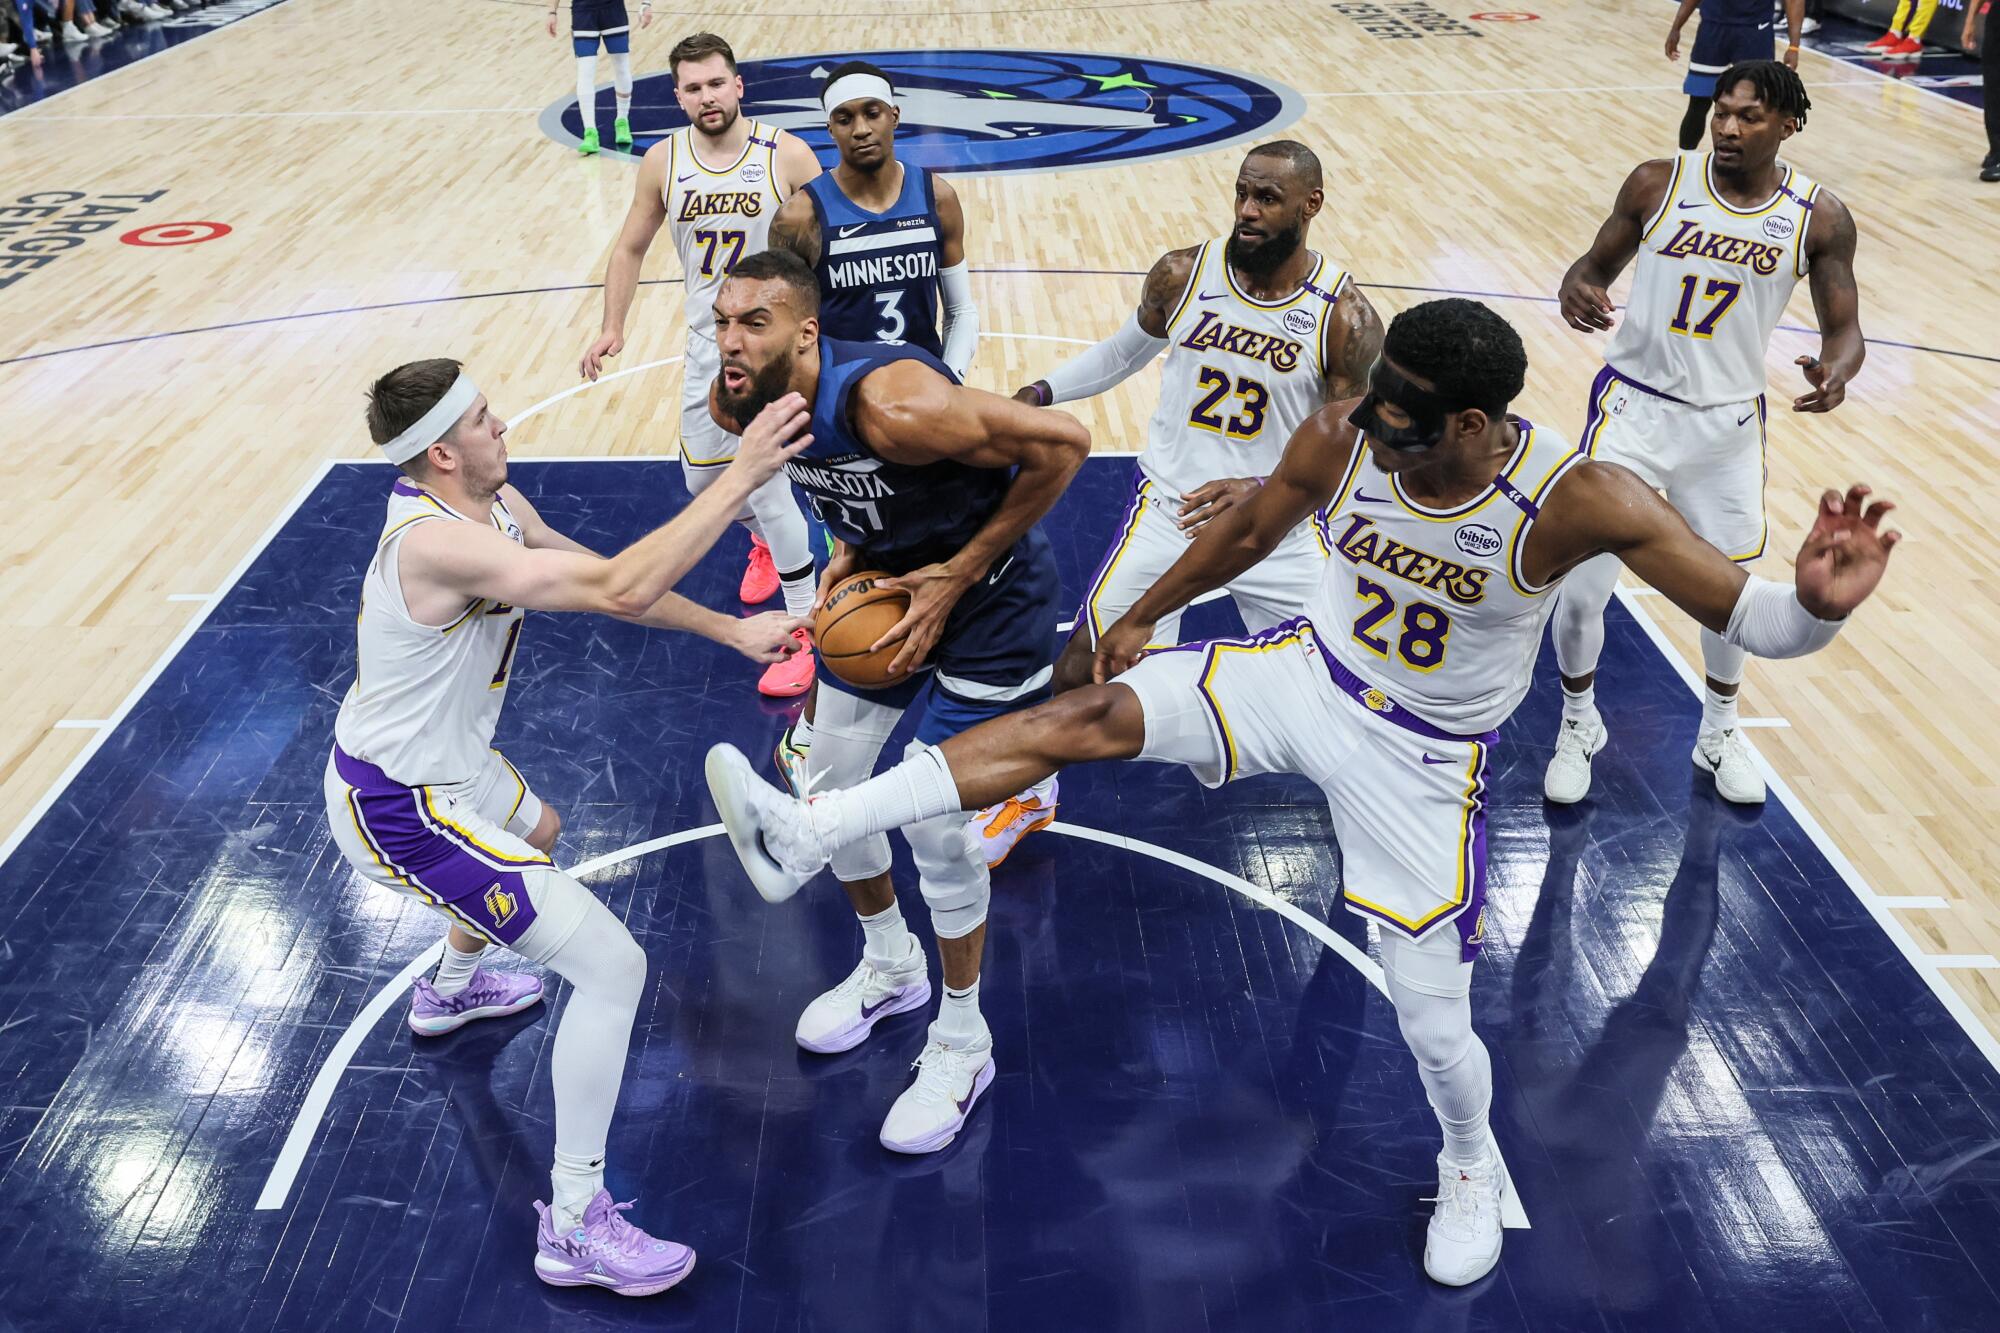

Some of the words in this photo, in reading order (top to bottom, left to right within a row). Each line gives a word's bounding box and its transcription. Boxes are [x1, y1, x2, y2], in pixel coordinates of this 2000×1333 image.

[1331, 2, 1424, 40] CENTER
[1384, 1, 1484, 37] TARGET
[677, 189, 762, 223] LAKERS
[1766, 219, 1792, 234] bibigo
[695, 229, 747, 279] 77
[1656, 219, 1784, 276] LAKERS
[827, 251, 937, 289] MINNESOTA
[874, 289, 906, 341] 3
[1286, 313, 1314, 329] bibigo
[1669, 273, 1744, 340] 17
[1180, 310, 1302, 374] LAKERS
[1188, 365, 1269, 441] 23
[1508, 489, 1523, 503] 44
[1334, 511, 1493, 606] LAKERS
[1459, 529, 1500, 550] bibigo
[1351, 575, 1453, 676] 28
